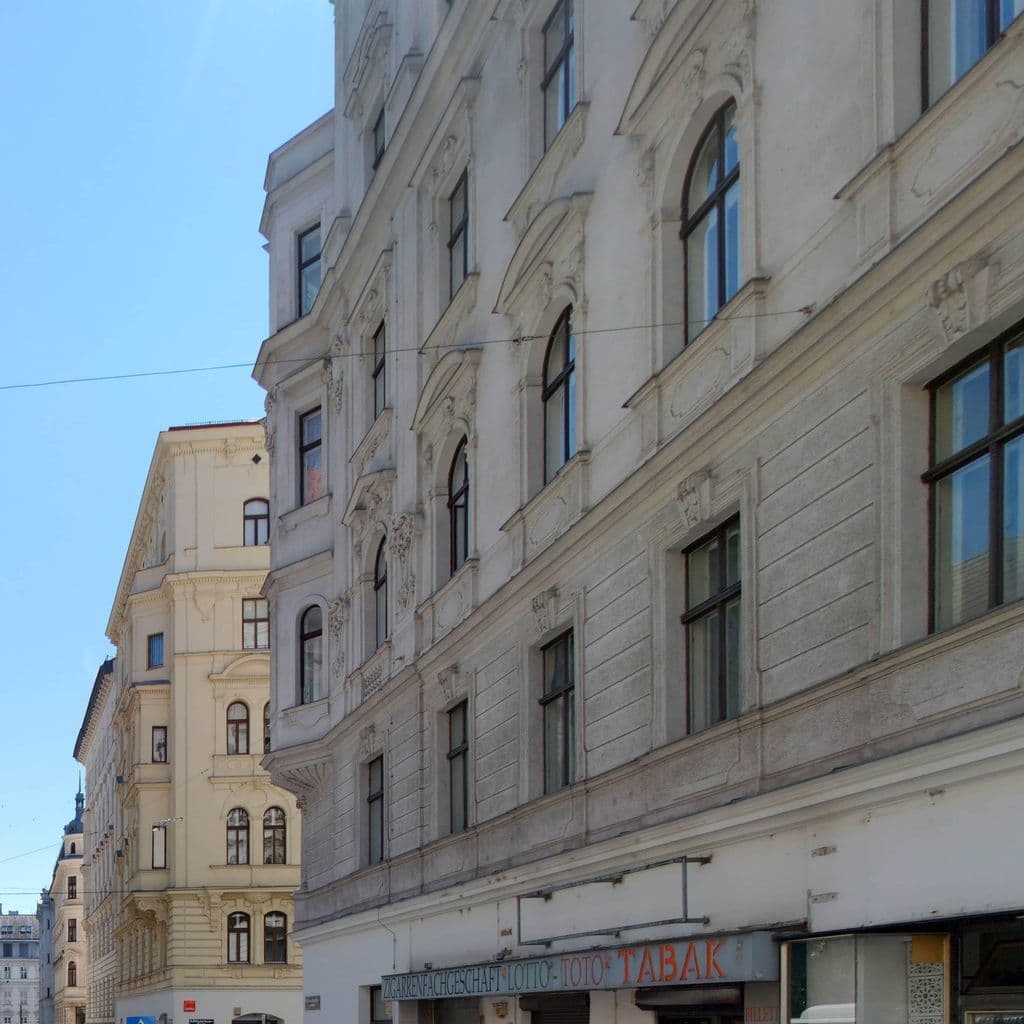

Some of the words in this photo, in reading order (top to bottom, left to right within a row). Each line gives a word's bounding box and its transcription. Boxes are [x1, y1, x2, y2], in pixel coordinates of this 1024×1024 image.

[508, 960, 552, 991] LOTTO
[561, 954, 605, 987] TOTO
[618, 938, 729, 985] TABAK
